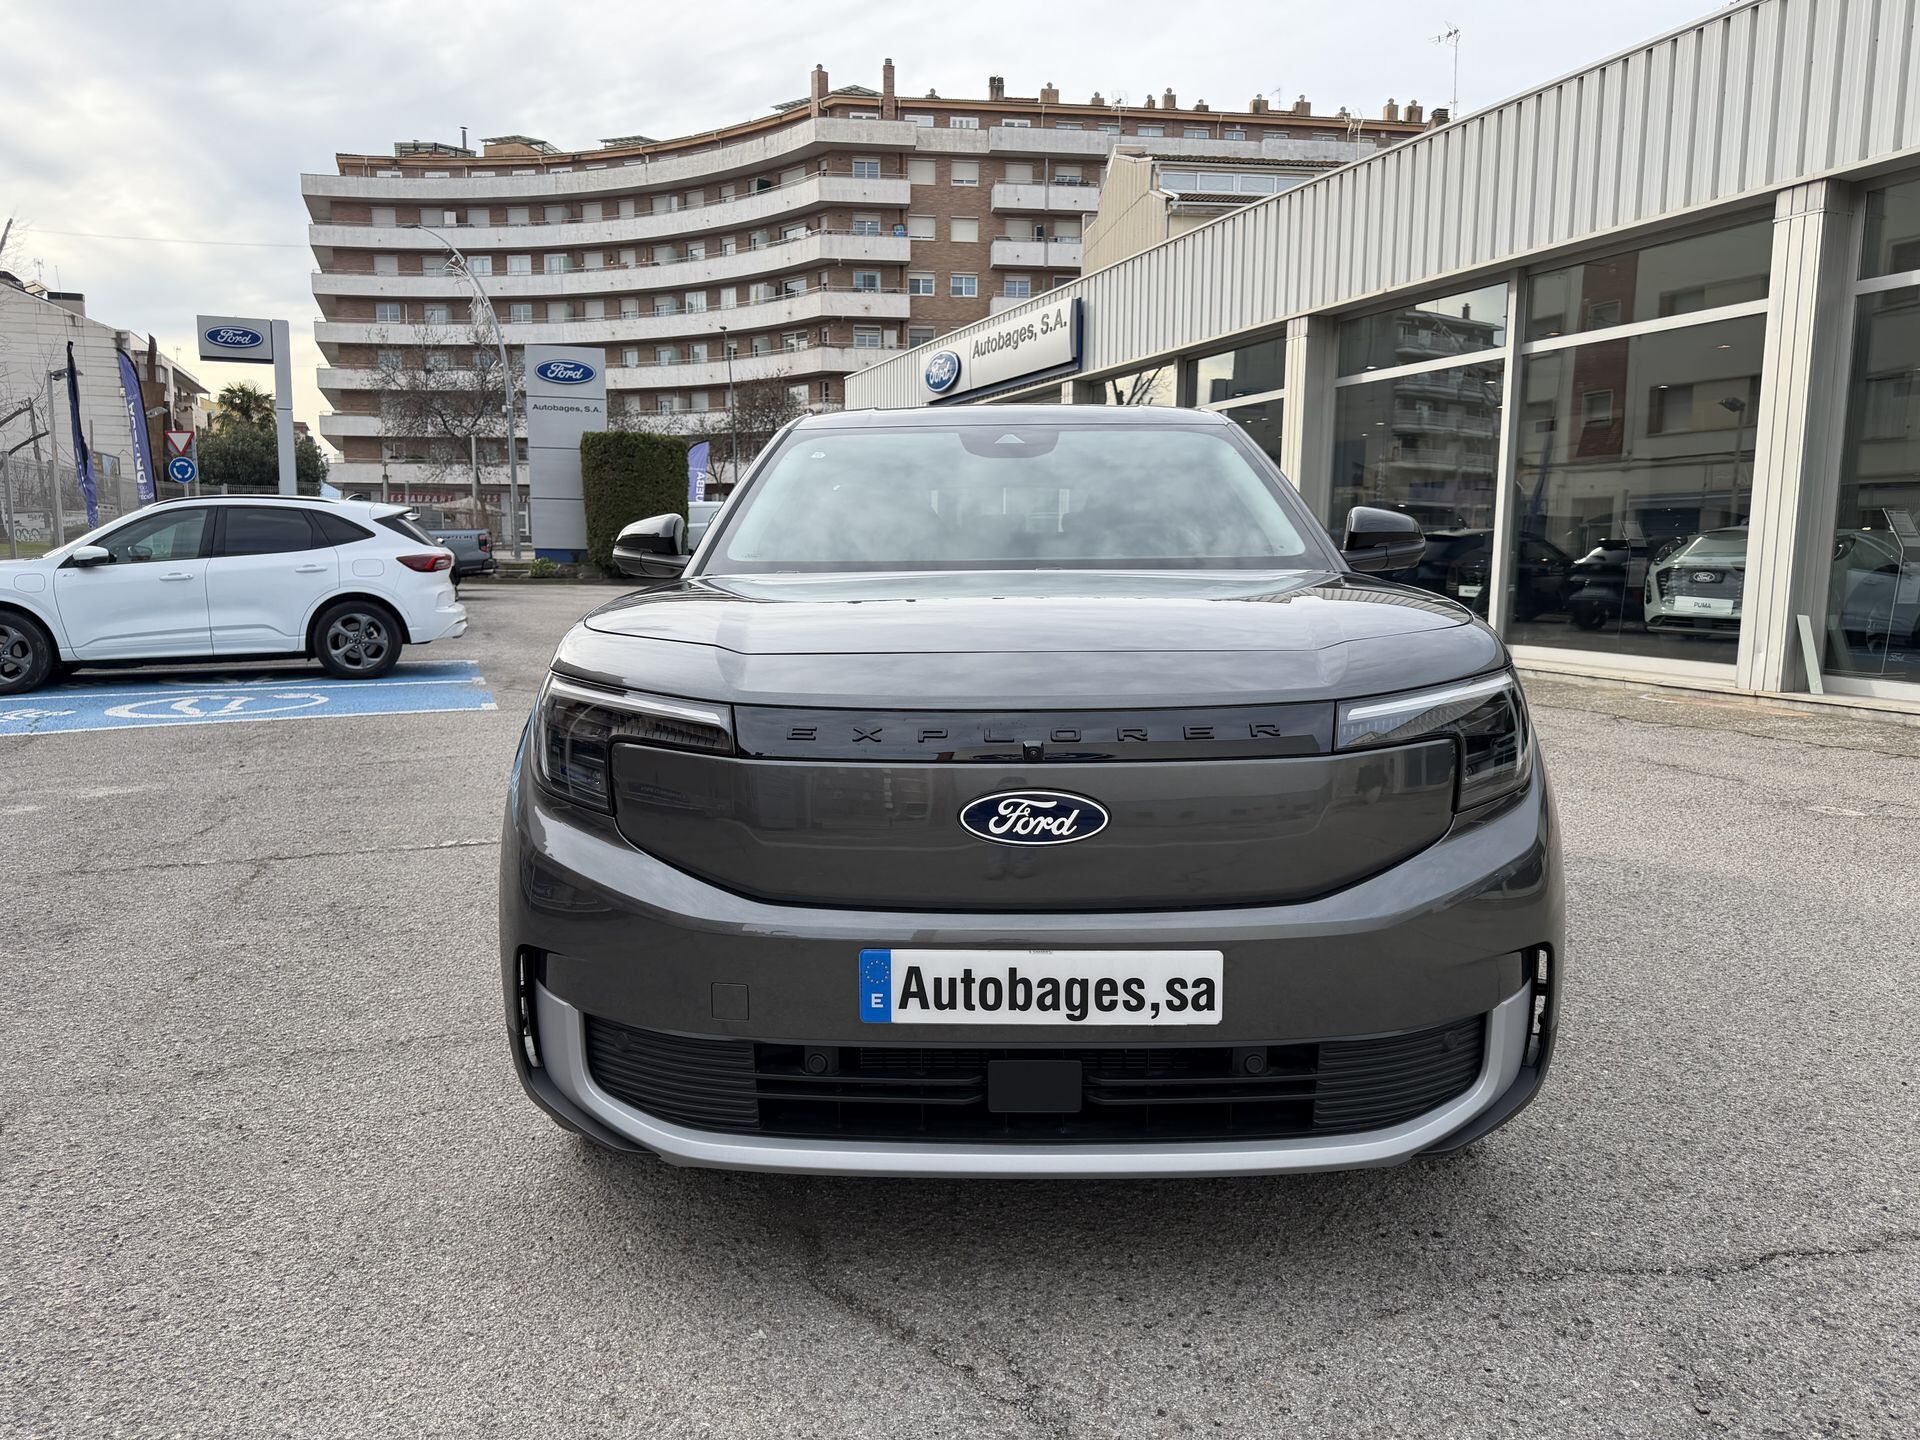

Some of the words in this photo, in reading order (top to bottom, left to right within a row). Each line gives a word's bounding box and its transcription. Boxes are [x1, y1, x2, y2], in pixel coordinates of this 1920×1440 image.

[217, 329, 252, 344] Ford
[972, 323, 1037, 359] Autobages,
[1041, 309, 1067, 335] S.A.
[547, 362, 585, 379] Ford
[928, 357, 951, 385] Ford
[532, 403, 583, 413] Autobages,
[584, 405, 602, 414] S.A.
[1693, 601, 1712, 609] PUMA
[786, 722, 1281, 743] EXPLORER
[988, 798, 1080, 836] Ford
[871, 993, 884, 1008] E
[898, 965, 1216, 1022] Autobages,sa
